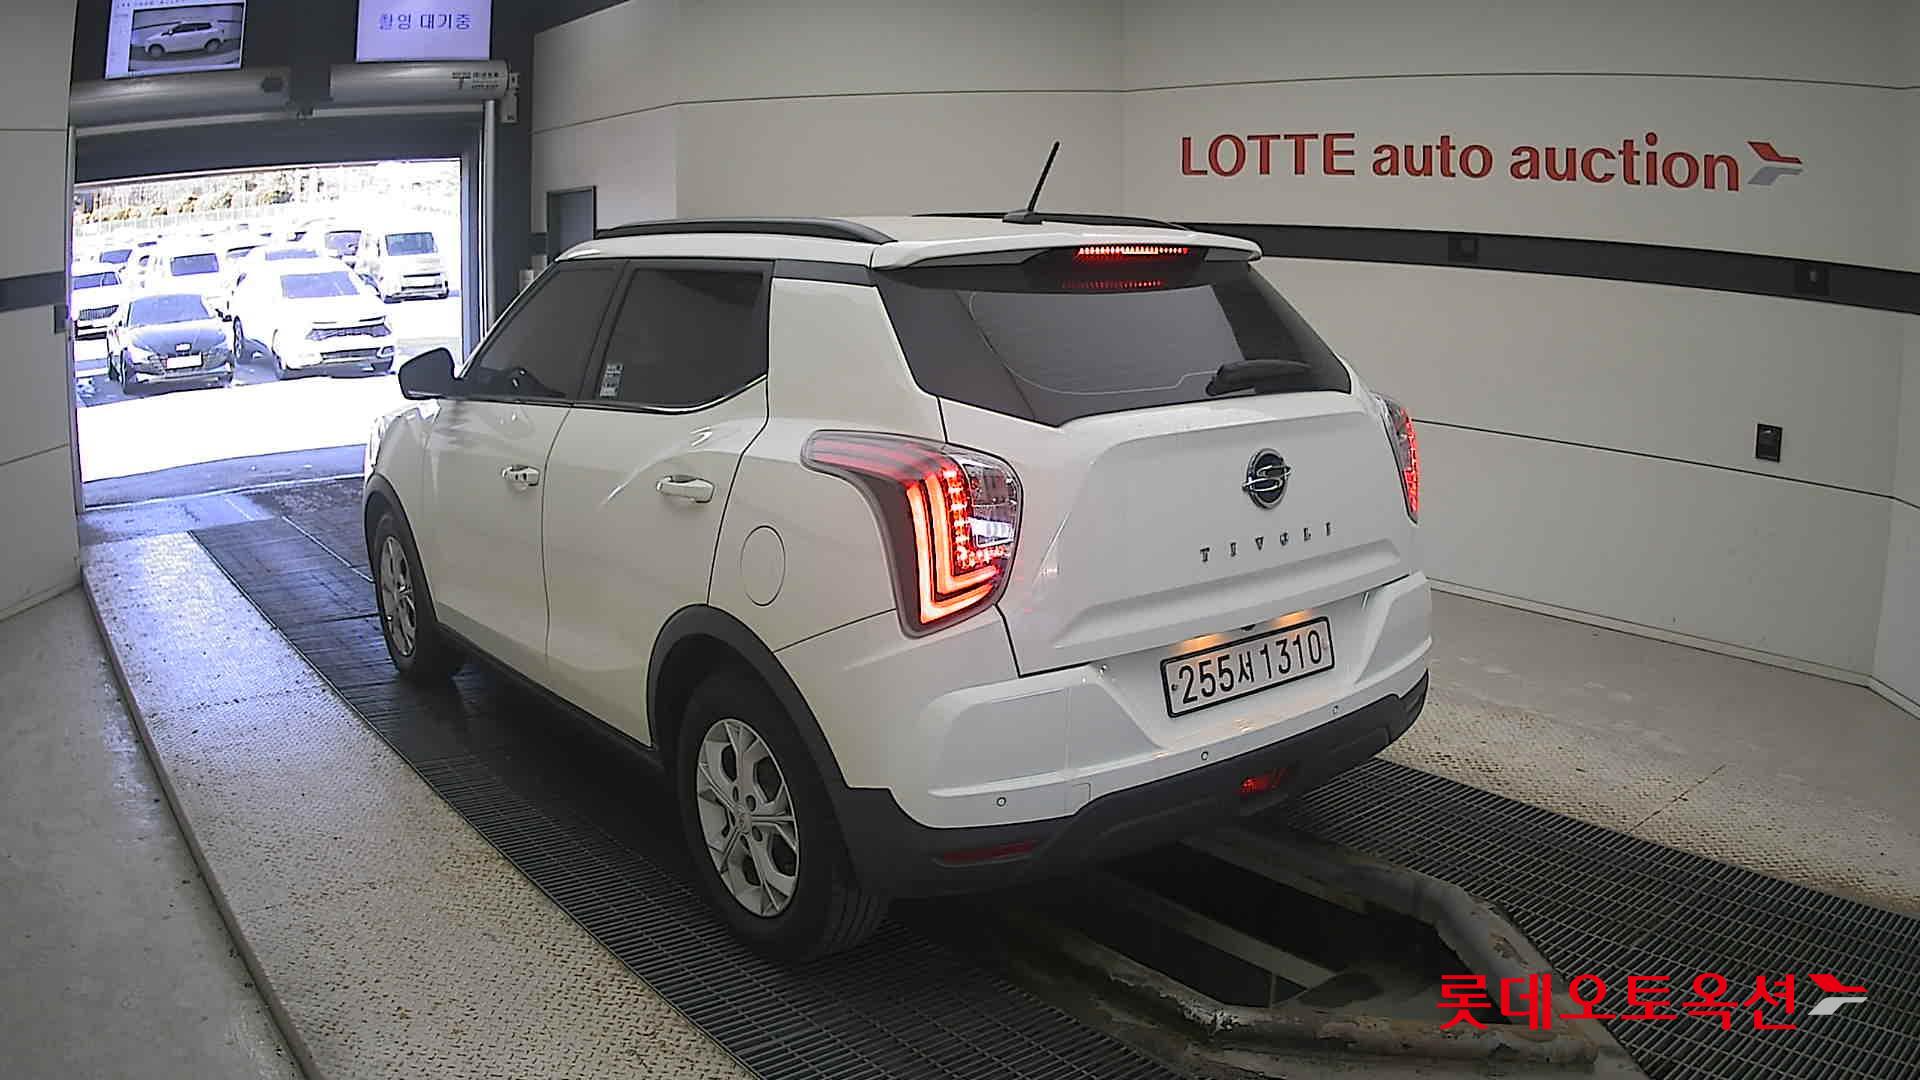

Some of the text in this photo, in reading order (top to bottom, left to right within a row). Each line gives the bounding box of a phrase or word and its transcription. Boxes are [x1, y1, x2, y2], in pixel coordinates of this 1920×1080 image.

[419, 13, 472, 31] 대기중
[1181, 131, 1740, 191] LOTTE auto auction
[1199, 521, 1334, 563] TIVOLI
